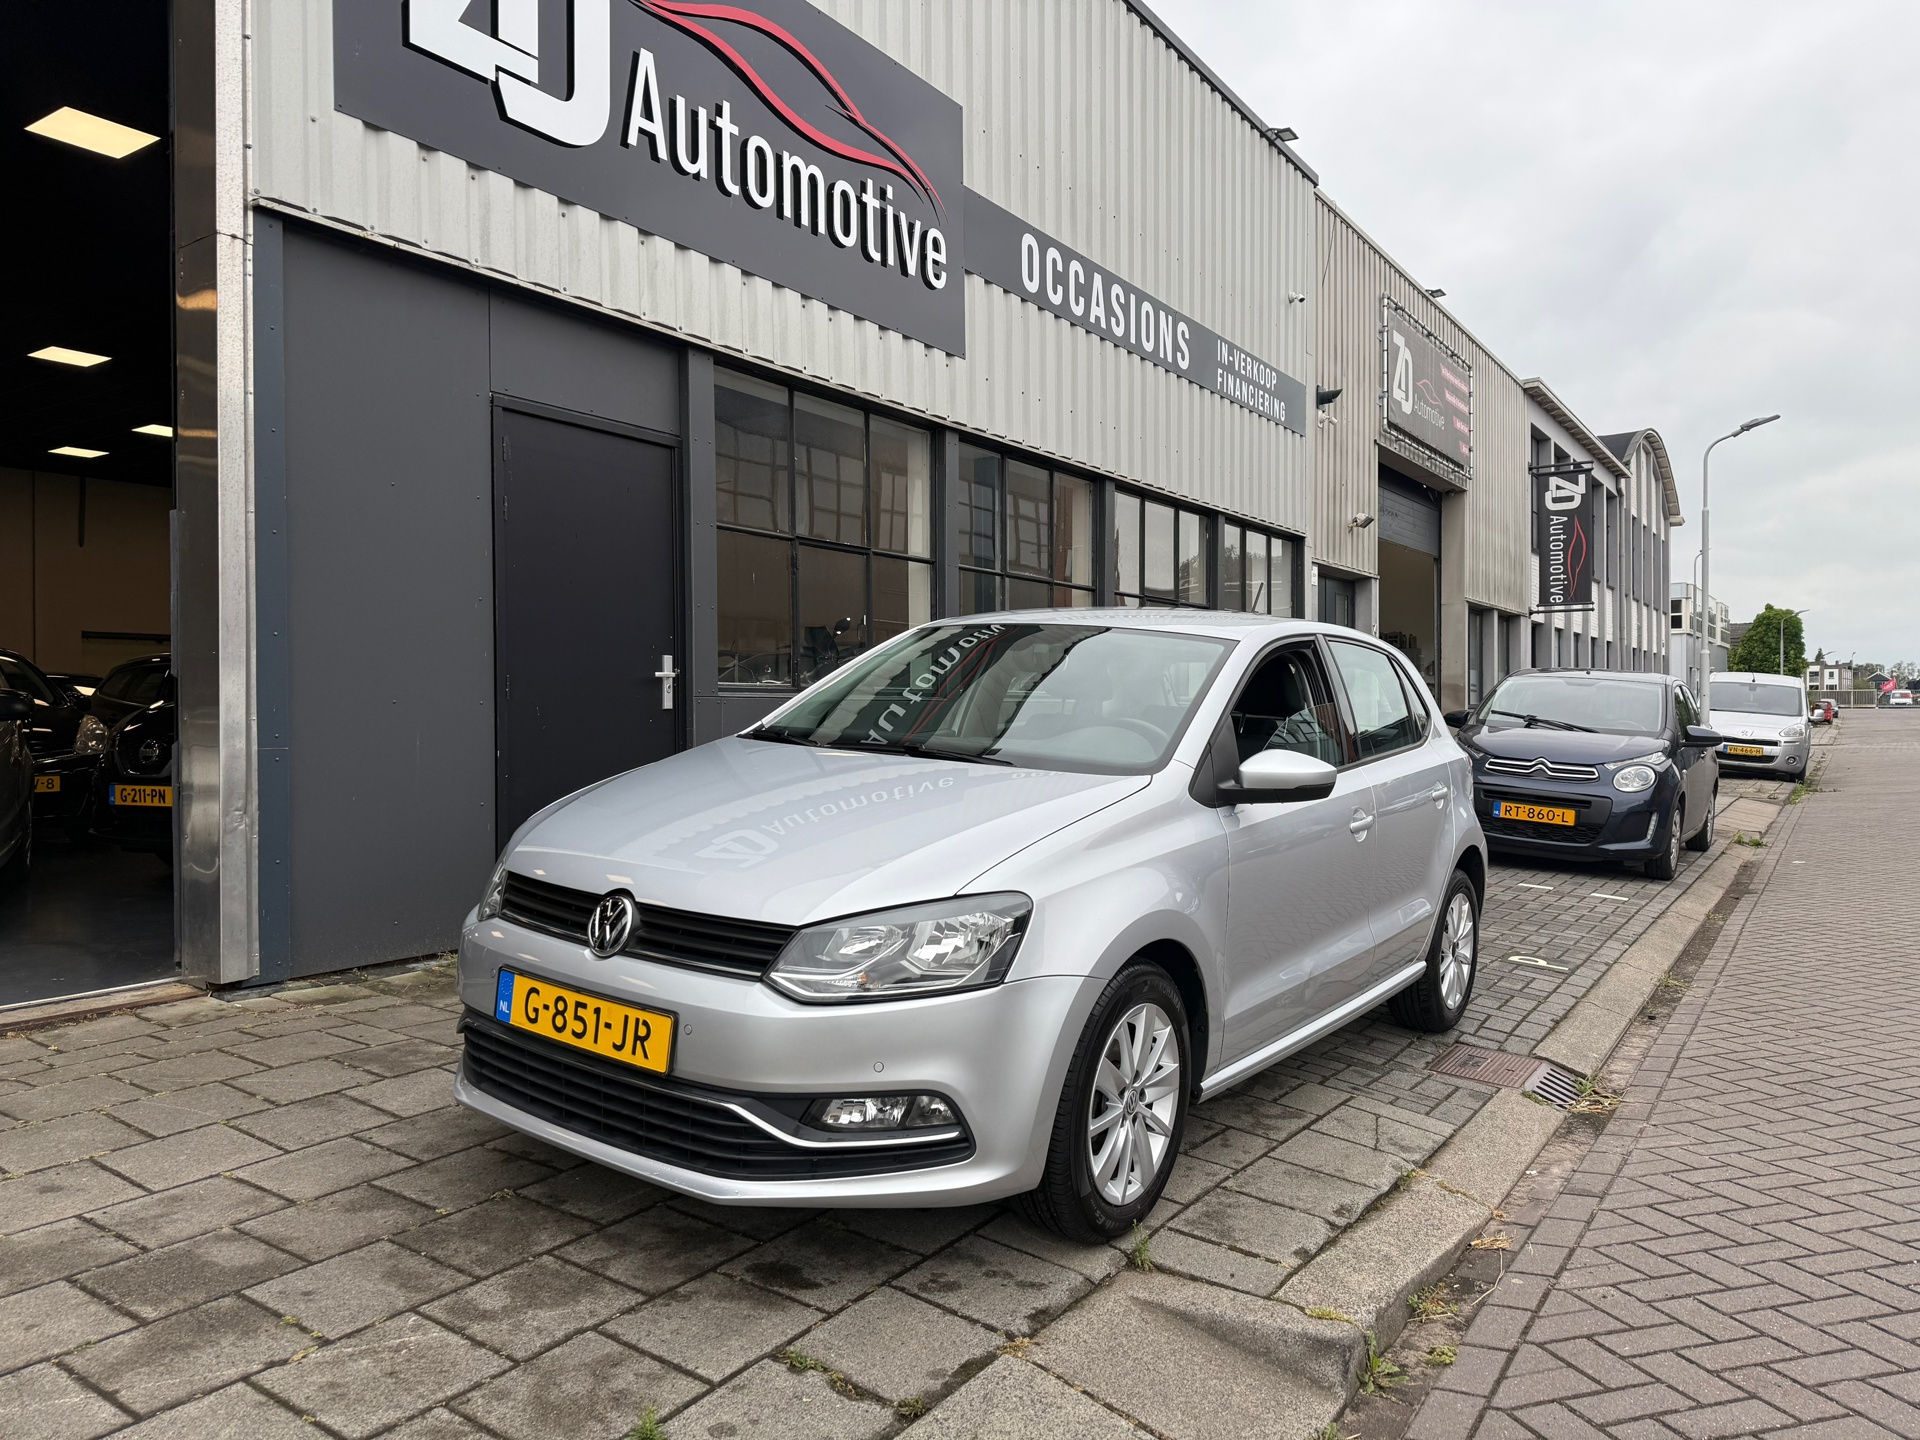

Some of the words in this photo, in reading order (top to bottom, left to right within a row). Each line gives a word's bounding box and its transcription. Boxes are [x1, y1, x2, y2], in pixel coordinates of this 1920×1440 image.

[626, 47, 948, 290] Automotive
[1020, 232, 1191, 370] OCCASIONS
[1216, 338, 1278, 391] IN-VERKOOP
[1216, 367, 1286, 422] FINANCIERING
[1549, 514, 1568, 604] Automotive
[120, 787, 167, 805] G-211-PN
[499, 999, 510, 1014] NL
[524, 986, 653, 1060] G-851-JR
